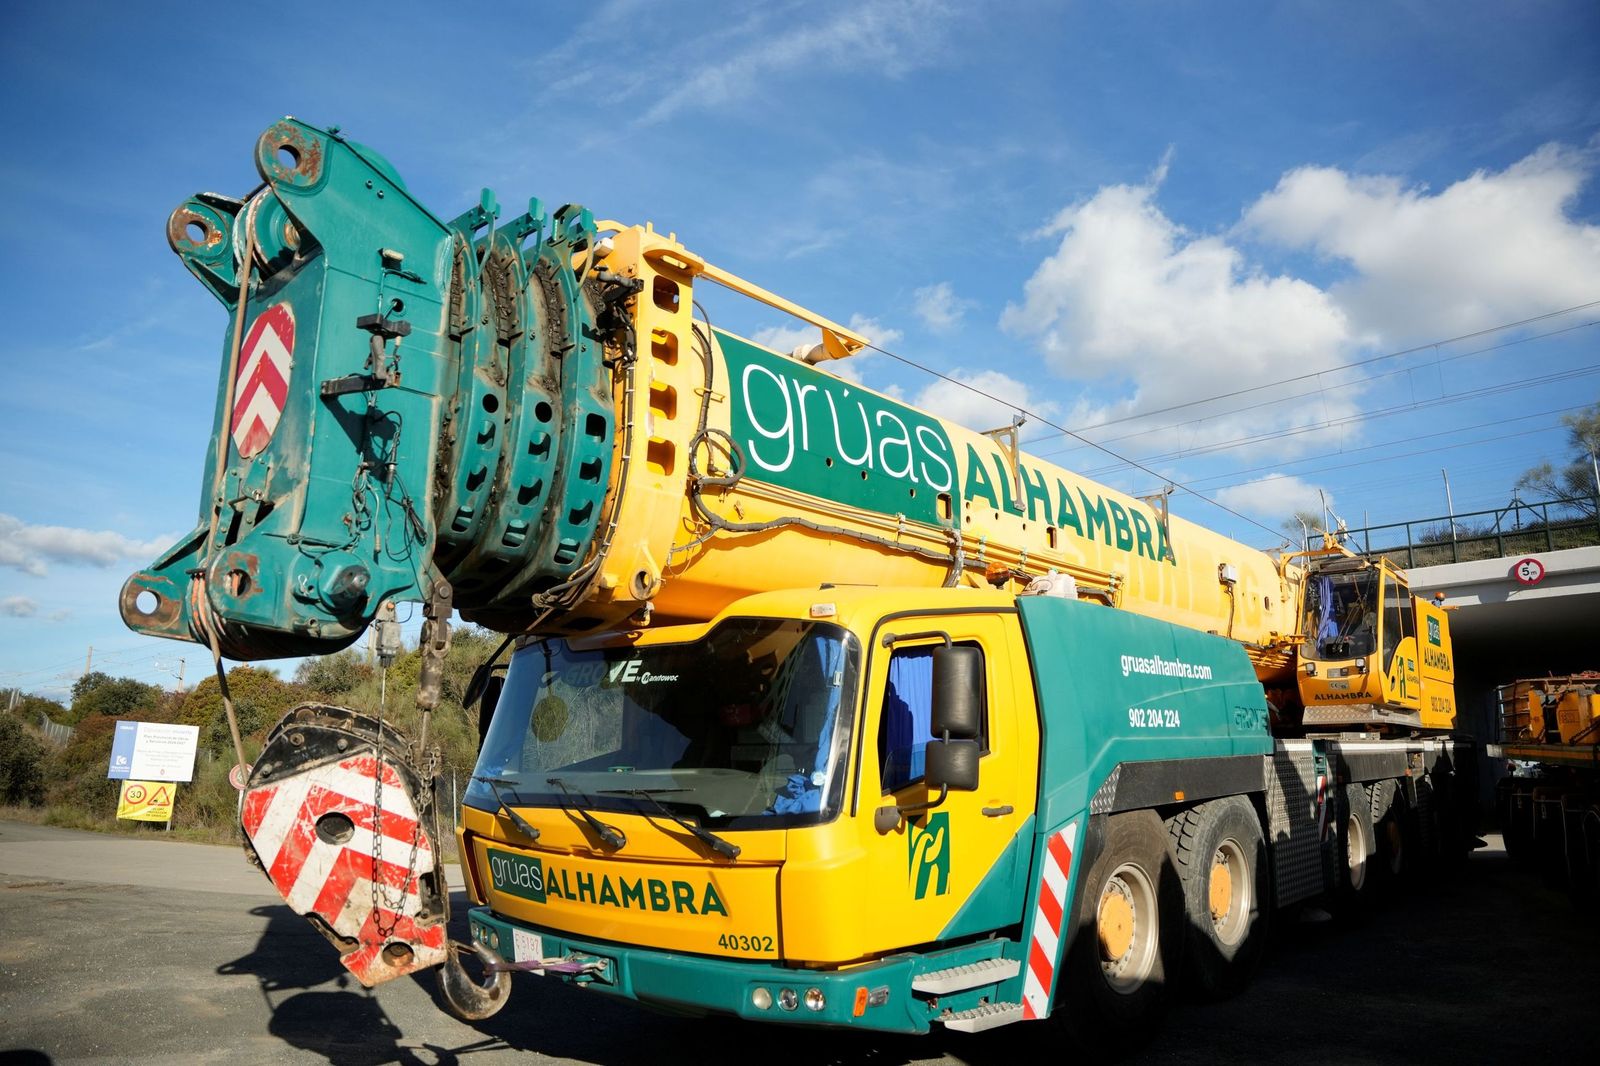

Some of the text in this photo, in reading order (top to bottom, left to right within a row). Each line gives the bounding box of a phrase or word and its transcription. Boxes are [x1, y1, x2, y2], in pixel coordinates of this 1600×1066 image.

[742, 363, 1177, 567] grúas ALHAMBRA
[1522, 567, 1530, 576] 5
[1121, 654, 1212, 680] gruasalhambra.com
[1424, 647, 1450, 672] ALHAMBRA
[1314, 691, 1373, 701] ALHAMBRA
[1129, 708, 1181, 728] 902 204 224
[130, 790, 142, 798] 30
[491, 854, 729, 917] grúas ALHAMBRA
[718, 933, 775, 953] 40302
